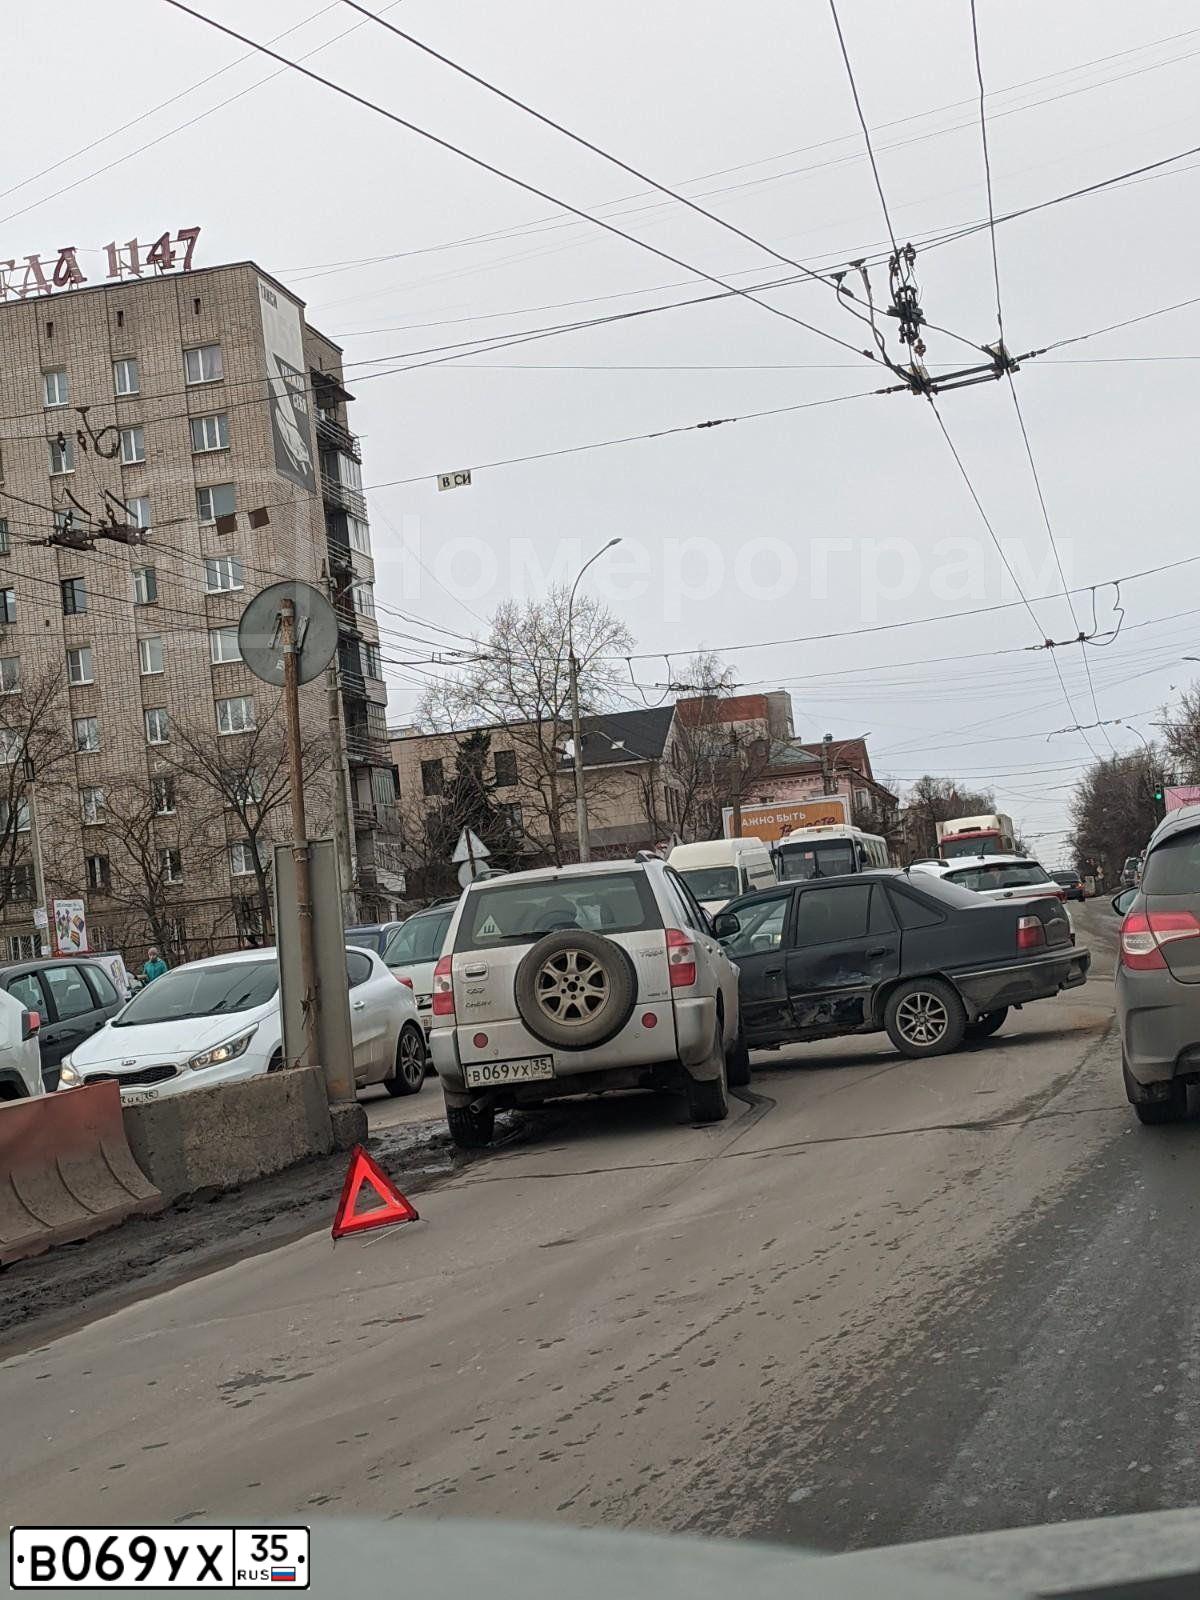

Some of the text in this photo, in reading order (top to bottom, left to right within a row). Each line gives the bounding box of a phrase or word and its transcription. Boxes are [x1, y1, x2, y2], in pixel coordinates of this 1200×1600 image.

[103, 226, 201, 278] 1147
[442, 477, 450, 488] В
[740, 811, 806, 828] АЖНО БЫТЬ
[483, 924, 495, 934] Ш
[472, 1059, 547, 1082] В069УХ 35
